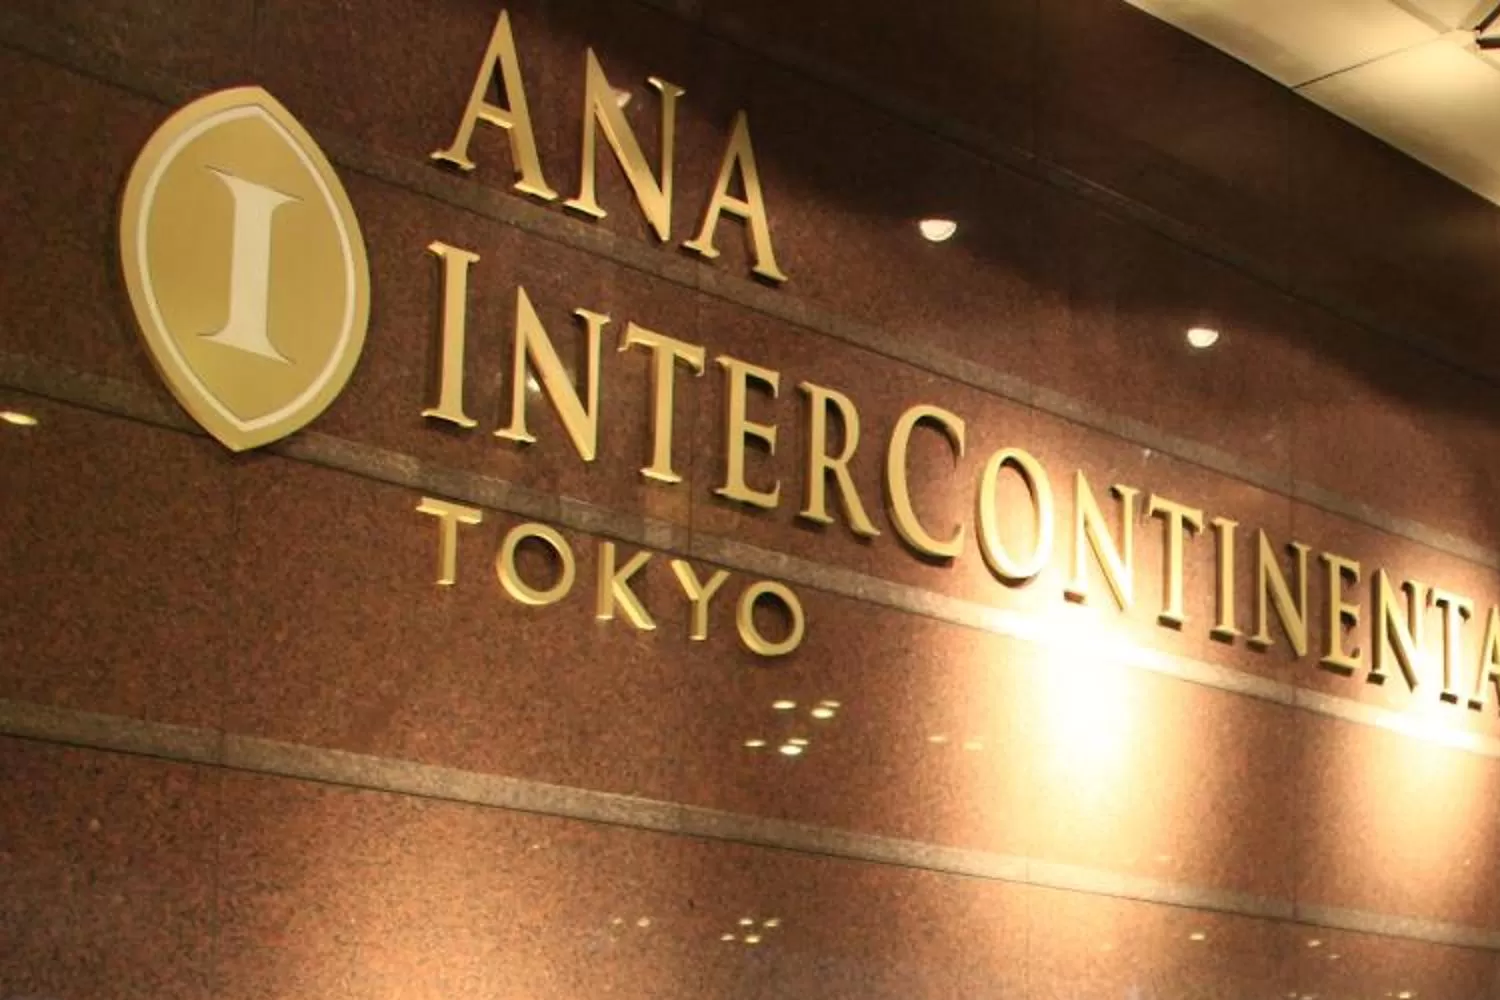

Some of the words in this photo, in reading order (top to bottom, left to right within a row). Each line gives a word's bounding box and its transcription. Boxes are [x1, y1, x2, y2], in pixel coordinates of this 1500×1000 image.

[430, 8, 787, 283] ANA
[196, 164, 304, 366] I
[416, 497, 805, 657] TOKYO
